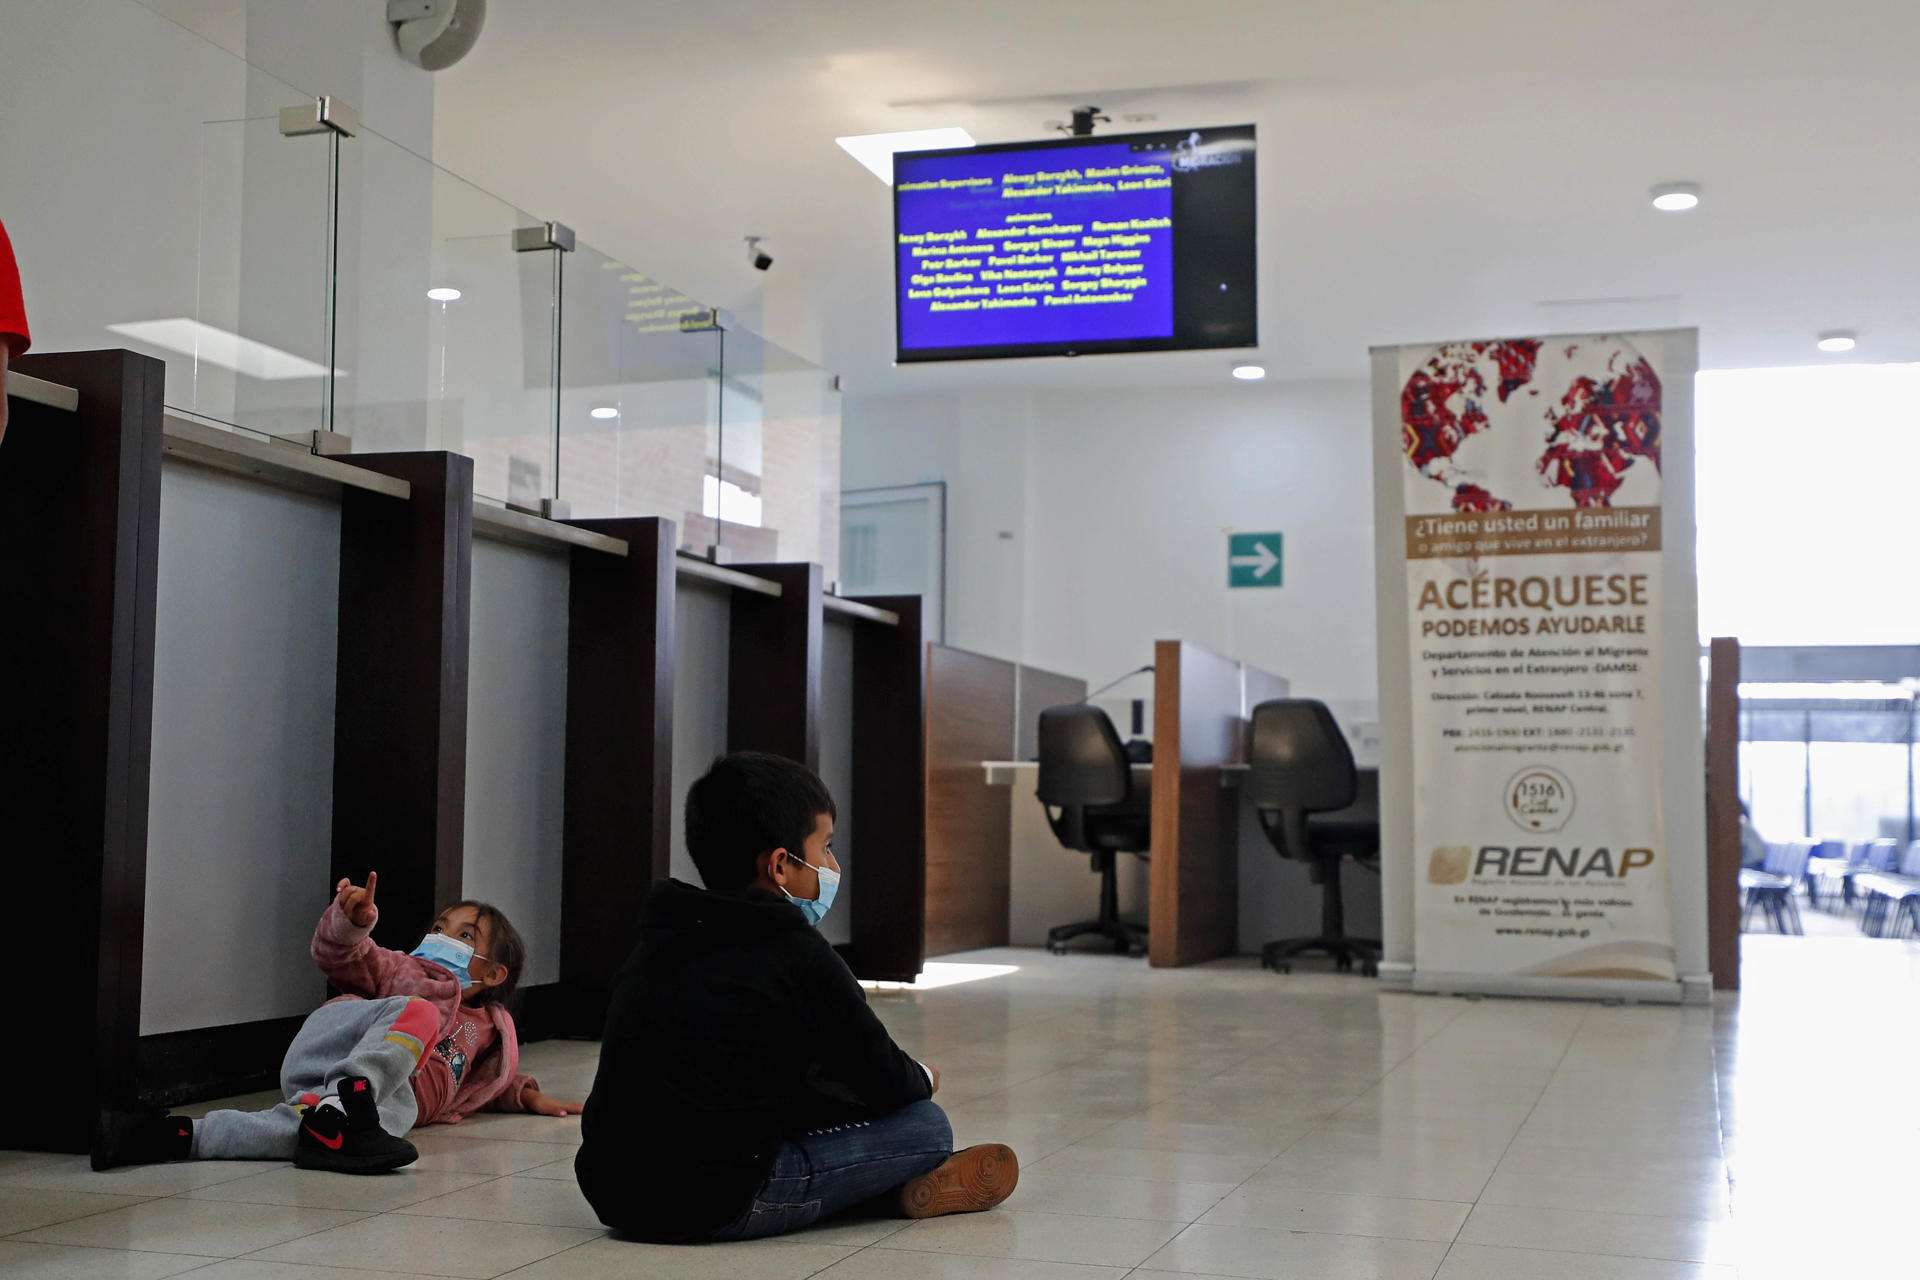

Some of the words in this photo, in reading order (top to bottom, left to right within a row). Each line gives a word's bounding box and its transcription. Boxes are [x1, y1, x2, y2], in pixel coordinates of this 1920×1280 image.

[1415, 517, 1479, 538] ¿Tiene
[1483, 515, 1538, 532] usted
[1544, 517, 1570, 530] un
[1574, 512, 1650, 530] familiar
[1419, 544, 1428, 552] o
[1431, 540, 1472, 555] amigo
[1475, 540, 1500, 554] que
[1503, 537, 1532, 550] vive
[1535, 538, 1552, 548] en
[1556, 534, 1569, 547] el
[1572, 532, 1649, 549] extranjero?
[1417, 569, 1648, 611] ACÉRQUESE
[1422, 616, 1530, 637] PODEMOS
[1536, 614, 1646, 635] AYUDARLE
[1423, 649, 1507, 662] Departamento
[1510, 647, 1525, 658] de
[1528, 646, 1581, 659] Atención
[1585, 646, 1595, 658] al
[1598, 645, 1649, 660] Migrante
[1441, 664, 1492, 676] Servicios
[1495, 664, 1510, 674] en
[1512, 662, 1524, 674] el
[1526, 662, 1589, 677] Extranjero
[1521, 782, 1556, 797] 1516
[1474, 847, 1655, 877] RENAP
